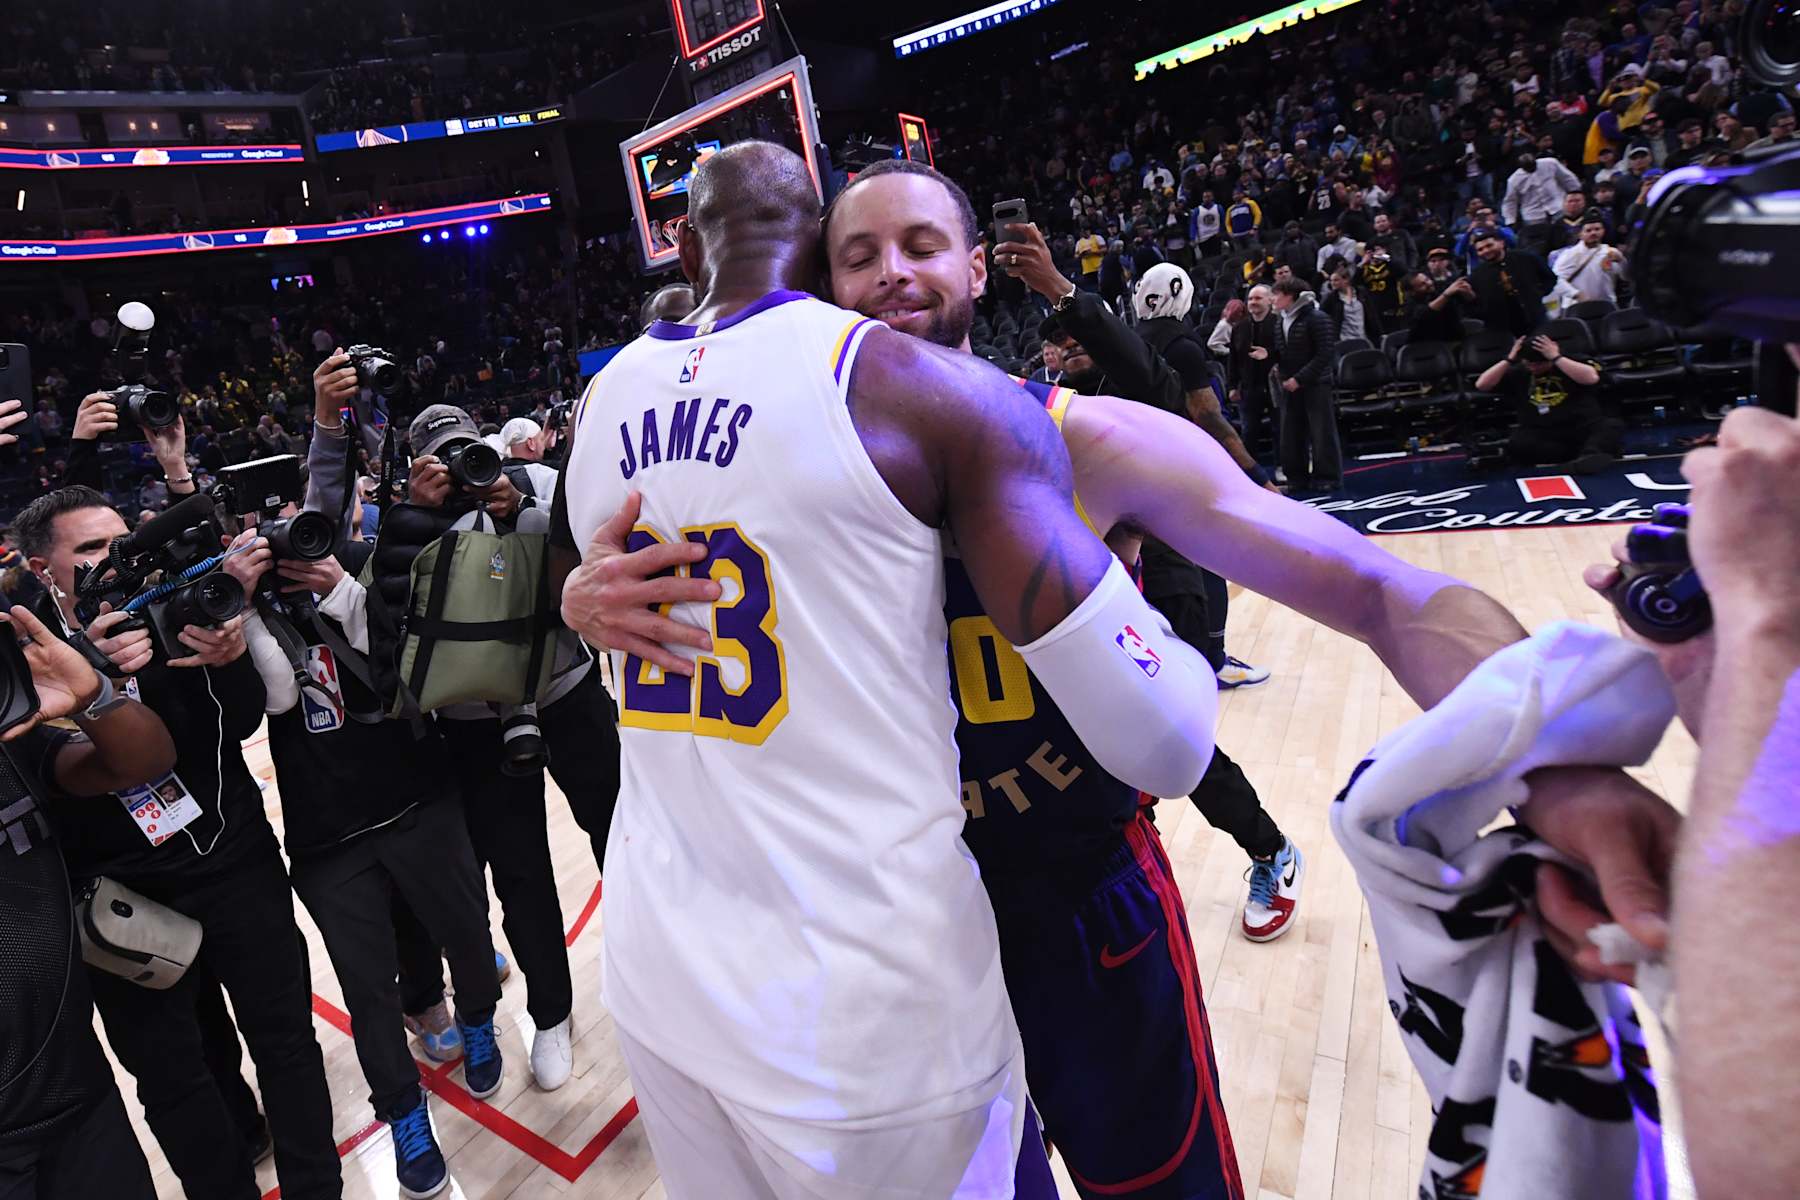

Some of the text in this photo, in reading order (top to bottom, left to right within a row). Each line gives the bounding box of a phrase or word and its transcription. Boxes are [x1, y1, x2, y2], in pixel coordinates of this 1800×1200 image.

[707, 26, 761, 63] TISSOT
[537, 109, 560, 120] FINAL
[242, 150, 264, 159] Google
[364, 221, 386, 231] Google
[386, 219, 404, 228] Cloud
[2, 245, 57, 256] Google Cloud
[427, 416, 458, 430] Supreme
[620, 397, 752, 480] JAMES
[619, 521, 789, 746] 23
[311, 710, 332, 728] NBA
